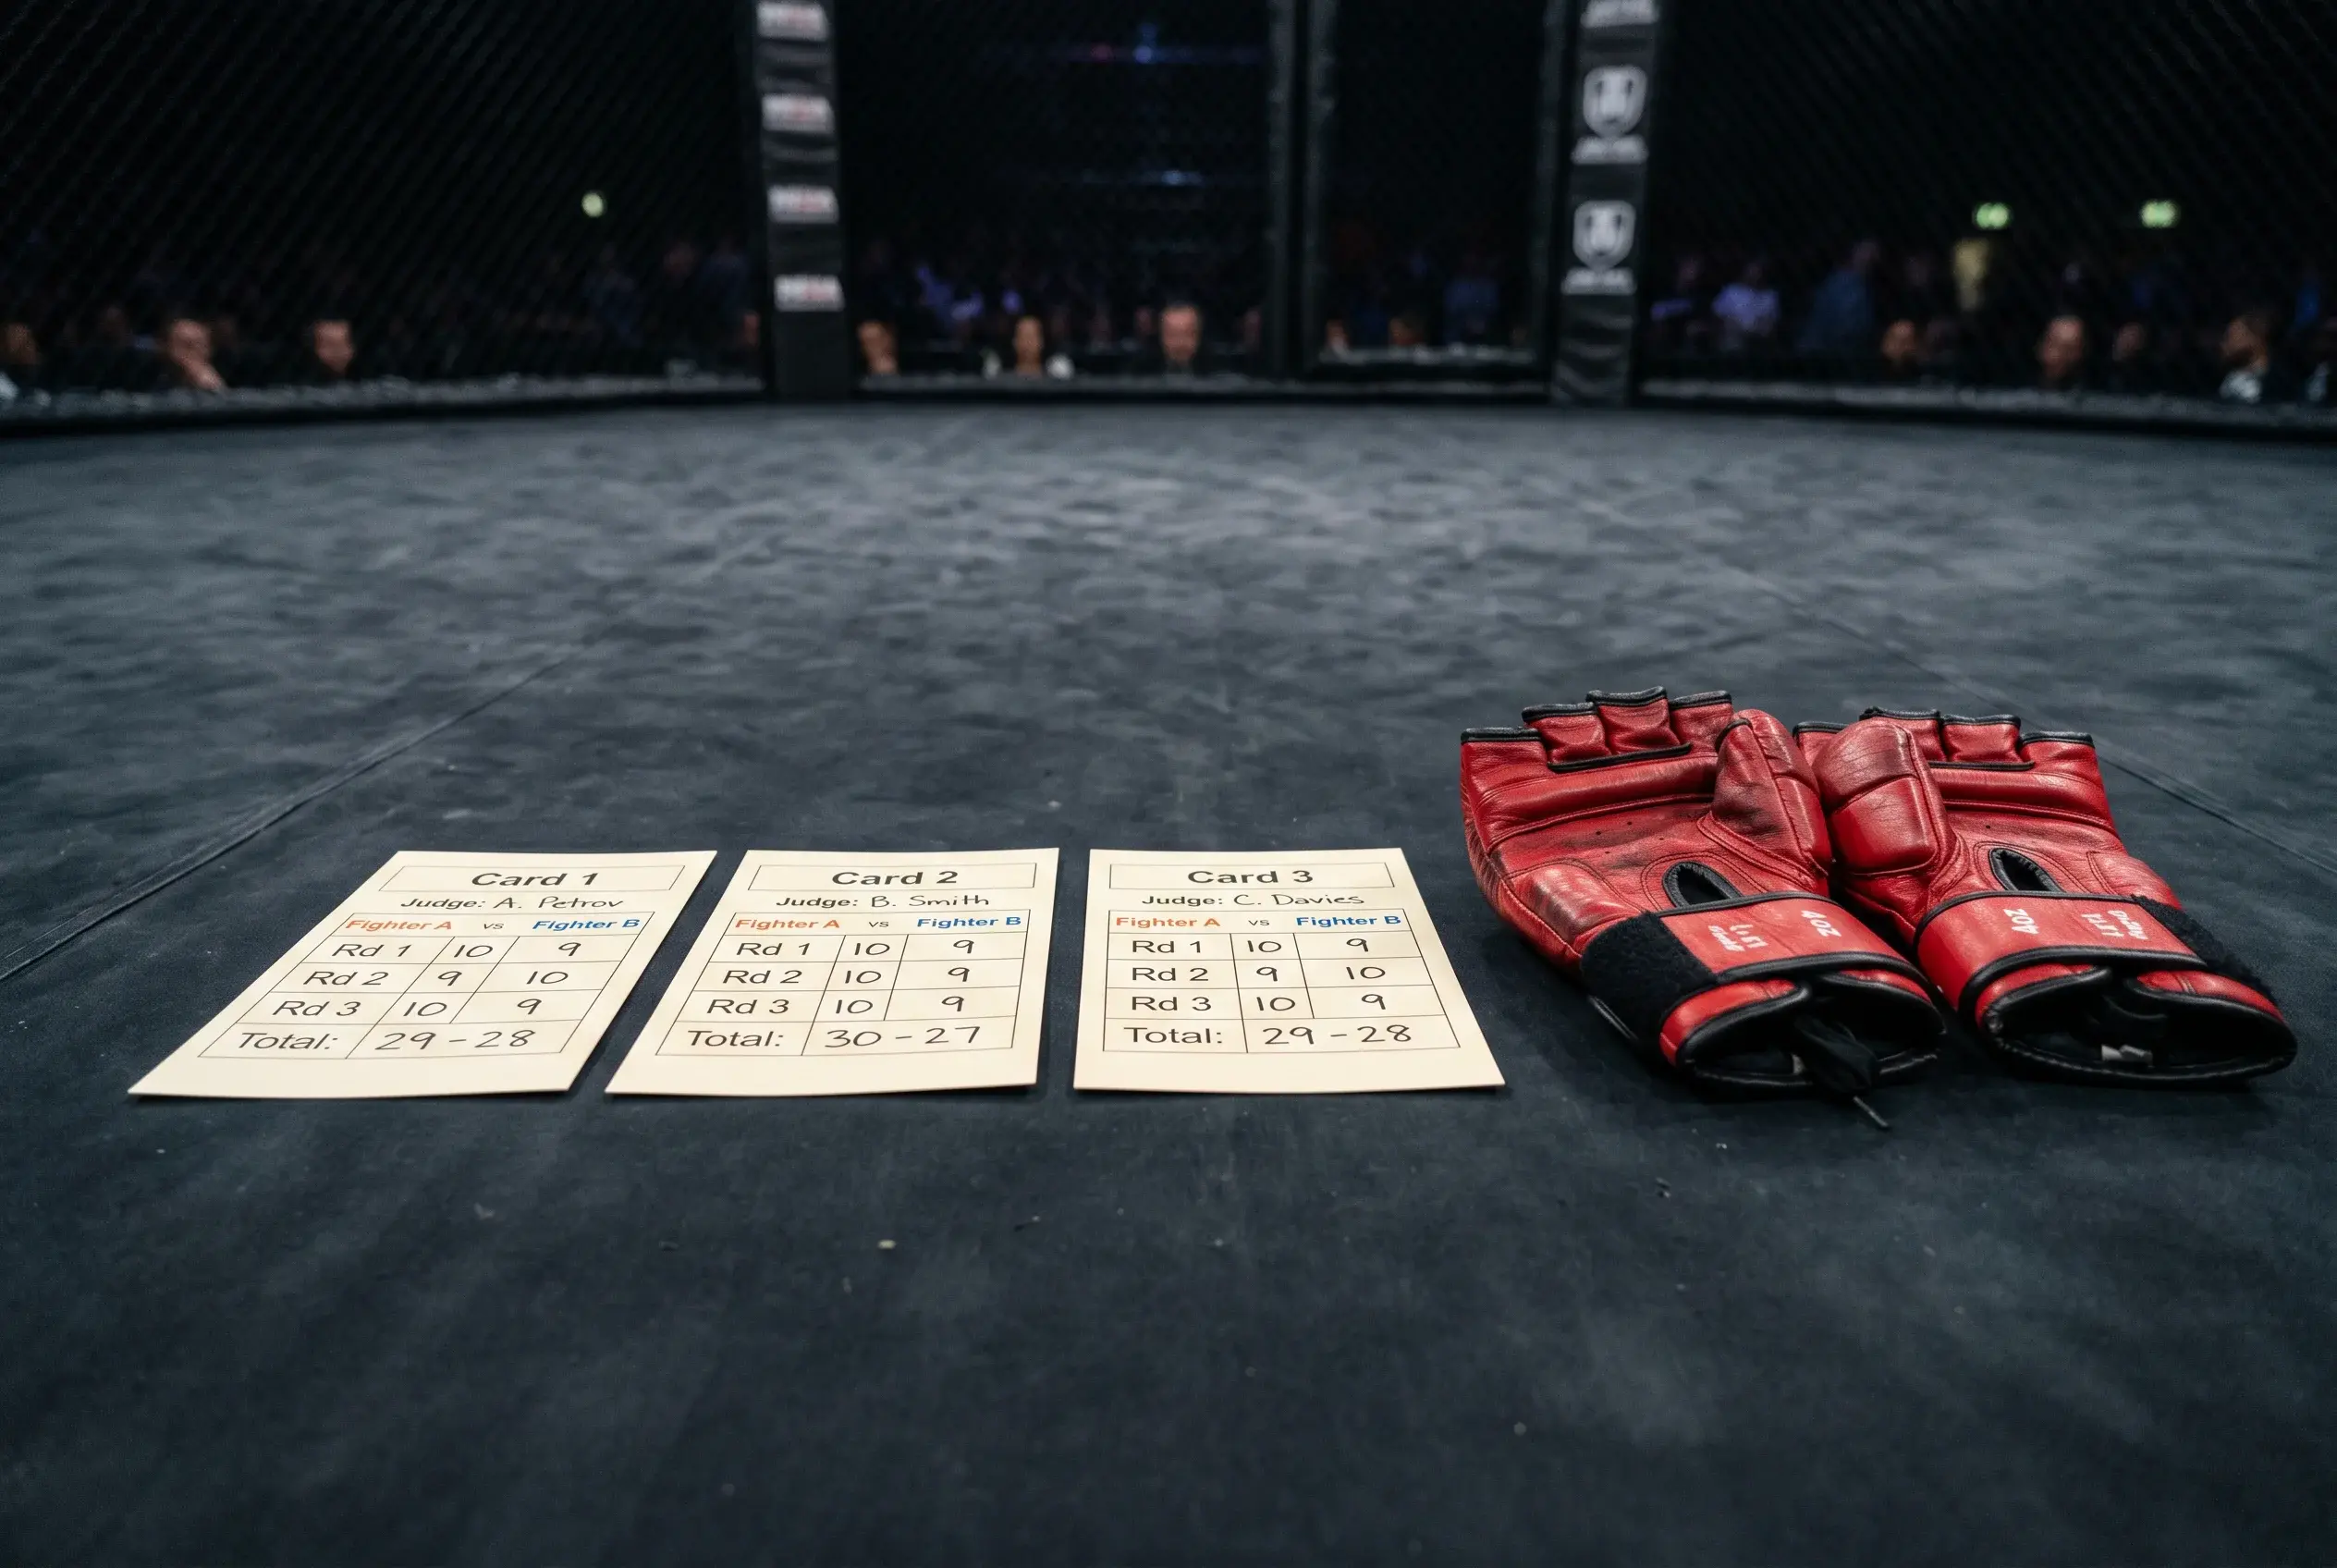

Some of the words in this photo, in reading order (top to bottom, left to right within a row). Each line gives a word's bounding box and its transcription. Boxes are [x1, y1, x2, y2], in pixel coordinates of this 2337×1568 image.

[472, 873, 567, 886] Card
[583, 873, 597, 885] 1
[832, 872, 923, 885] Card
[936, 871, 958, 883] 2
[1188, 871, 1278, 883] Card
[1292, 871, 1313, 882] 3
[401, 899, 482, 909] Judge:
[493, 897, 522, 909] A.
[539, 897, 623, 908] Petrov
[777, 898, 858, 908] Judge:
[871, 896, 896, 908] B.
[910, 895, 988, 906] Smith
[1143, 896, 1222, 906] Judge:
[1233, 894, 1261, 906] C.
[1271, 894, 1364, 905] Davies
[345, 919, 425, 934] Fighter
[426, 920, 453, 930] A
[483, 921, 504, 930] vs
[532, 921, 617, 931] Fighter
[736, 920, 817, 930] Fighter
[918, 919, 998, 928] Fighter
[1117, 918, 1196, 928] Fighter
[1205, 918, 1220, 926] A
[1297, 917, 1377, 927] Fighter
[332, 944, 384, 956] Rd
[398, 945, 411, 957] 1
[454, 945, 493, 957] 10
[558, 942, 581, 956] 9
[737, 943, 782, 955] Rd
[799, 943, 810, 955] 1
[855, 943, 890, 955] 10
[953, 940, 973, 953] 9
[1132, 940, 1174, 953] Rd
[1190, 941, 1200, 953] 1
[1248, 940, 1281, 952] 10
[1347, 938, 1368, 952] 9
[303, 972, 358, 985] Rd
[361, 972, 388, 985] 2
[438, 971, 462, 986] 9
[527, 972, 568, 984] 10
[723, 971, 771, 984] Rd
[780, 970, 801, 983] 2
[845, 971, 881, 984] 10
[948, 967, 970, 982] 9
[1132, 968, 1176, 981] Rd
[1190, 968, 1208, 981] 2
[1256, 967, 1278, 981] 9
[1346, 967, 1385, 979] 10
[273, 1001, 329, 1015] Rd
[336, 1001, 361, 1016] 3
[404, 1002, 447, 1016] 10
[518, 998, 542, 1014] 9
[707, 999, 757, 1014] Rd
[769, 999, 789, 1013] 3
[836, 999, 873, 1013] 10
[942, 997, 964, 1011] 9
[1132, 997, 1177, 1011] Rd
[1193, 997, 1211, 1011] 3
[1256, 997, 1295, 1011] 10
[1362, 994, 1386, 1010] 9
[239, 1033, 337, 1049] Total:
[375, 1032, 435, 1049] 29
[475, 1030, 535, 1047] 28
[688, 1031, 783, 1047] Total:
[825, 1030, 881, 1047] 30
[925, 1026, 980, 1044] 27
[1124, 1027, 1222, 1043] Total:
[1263, 1027, 1314, 1044] 29
[1357, 1024, 1411, 1042] 28
